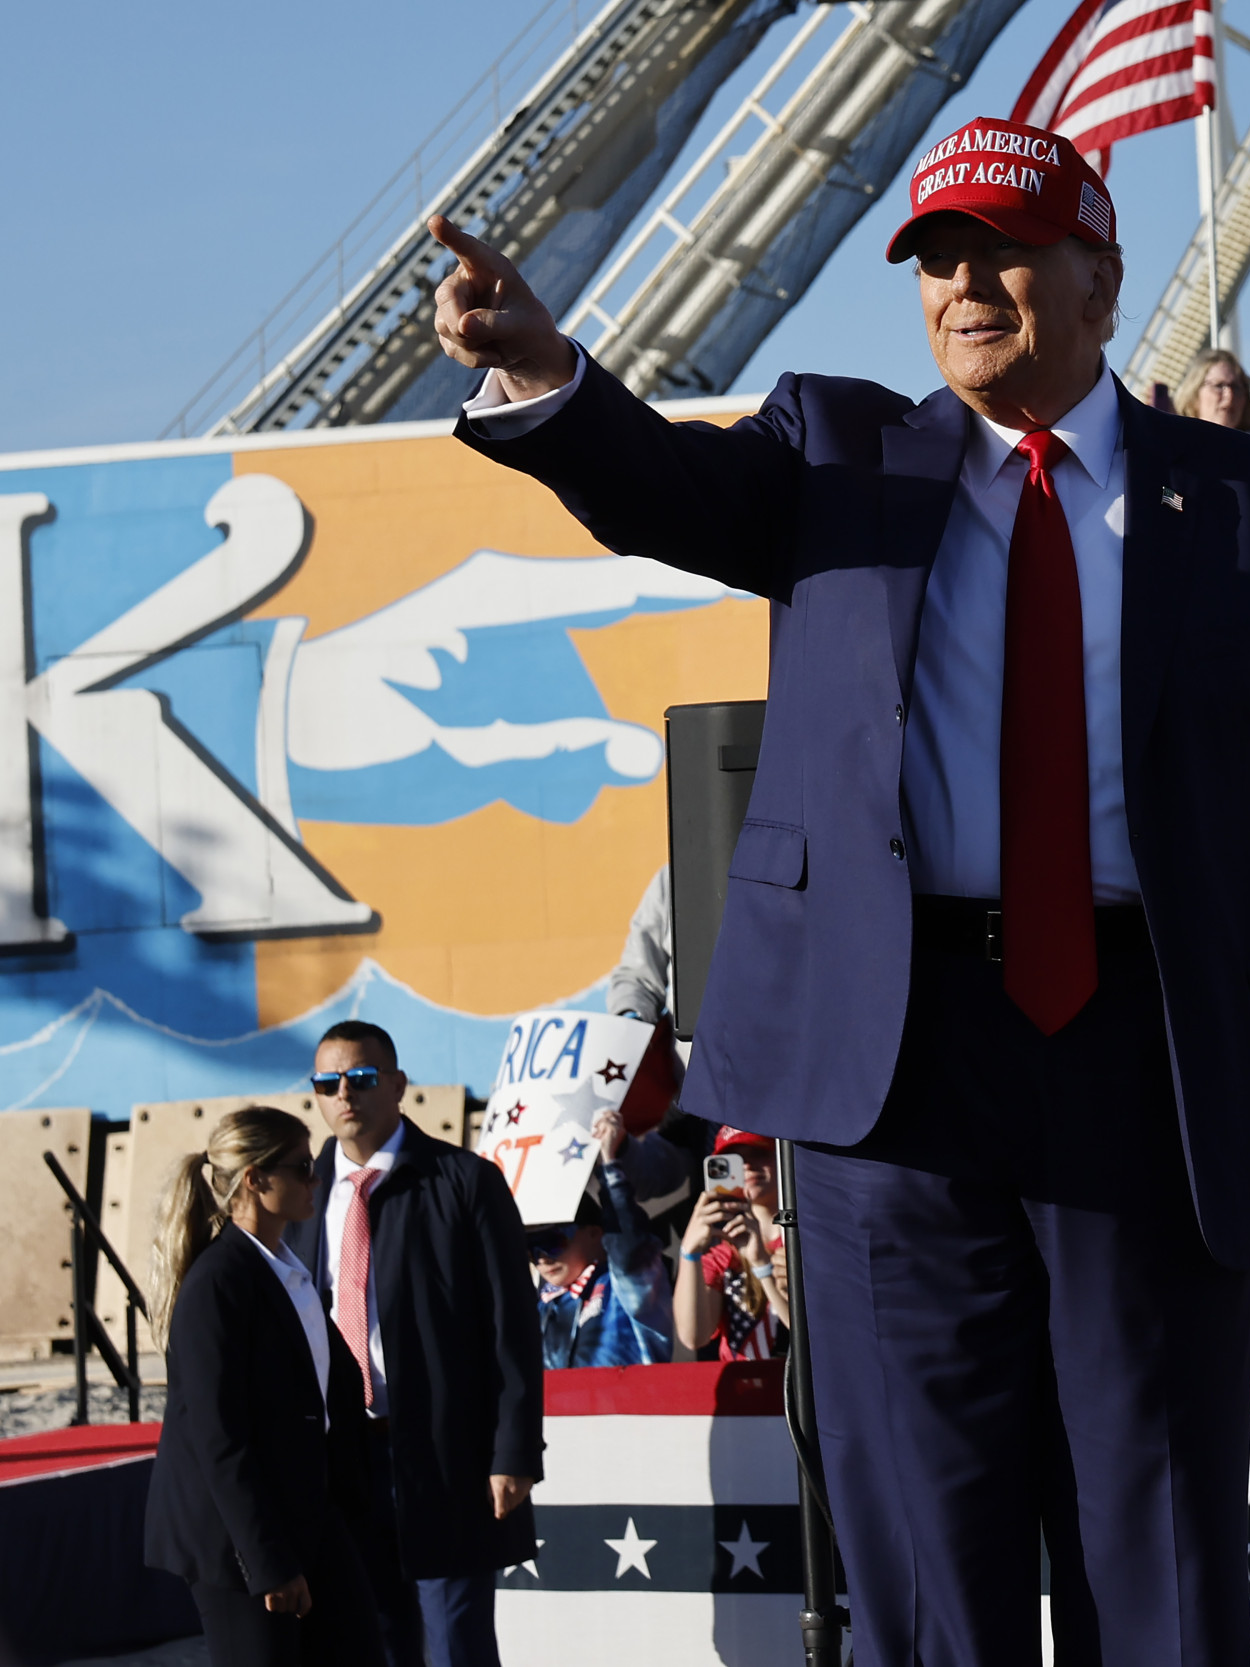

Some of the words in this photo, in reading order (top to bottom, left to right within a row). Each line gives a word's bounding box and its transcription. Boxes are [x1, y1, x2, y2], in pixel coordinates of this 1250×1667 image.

[913, 134, 958, 178] MAKE
[959, 128, 1061, 167] AMERICA
[917, 163, 971, 205] GREAT
[971, 162, 1045, 196] AGAIN
